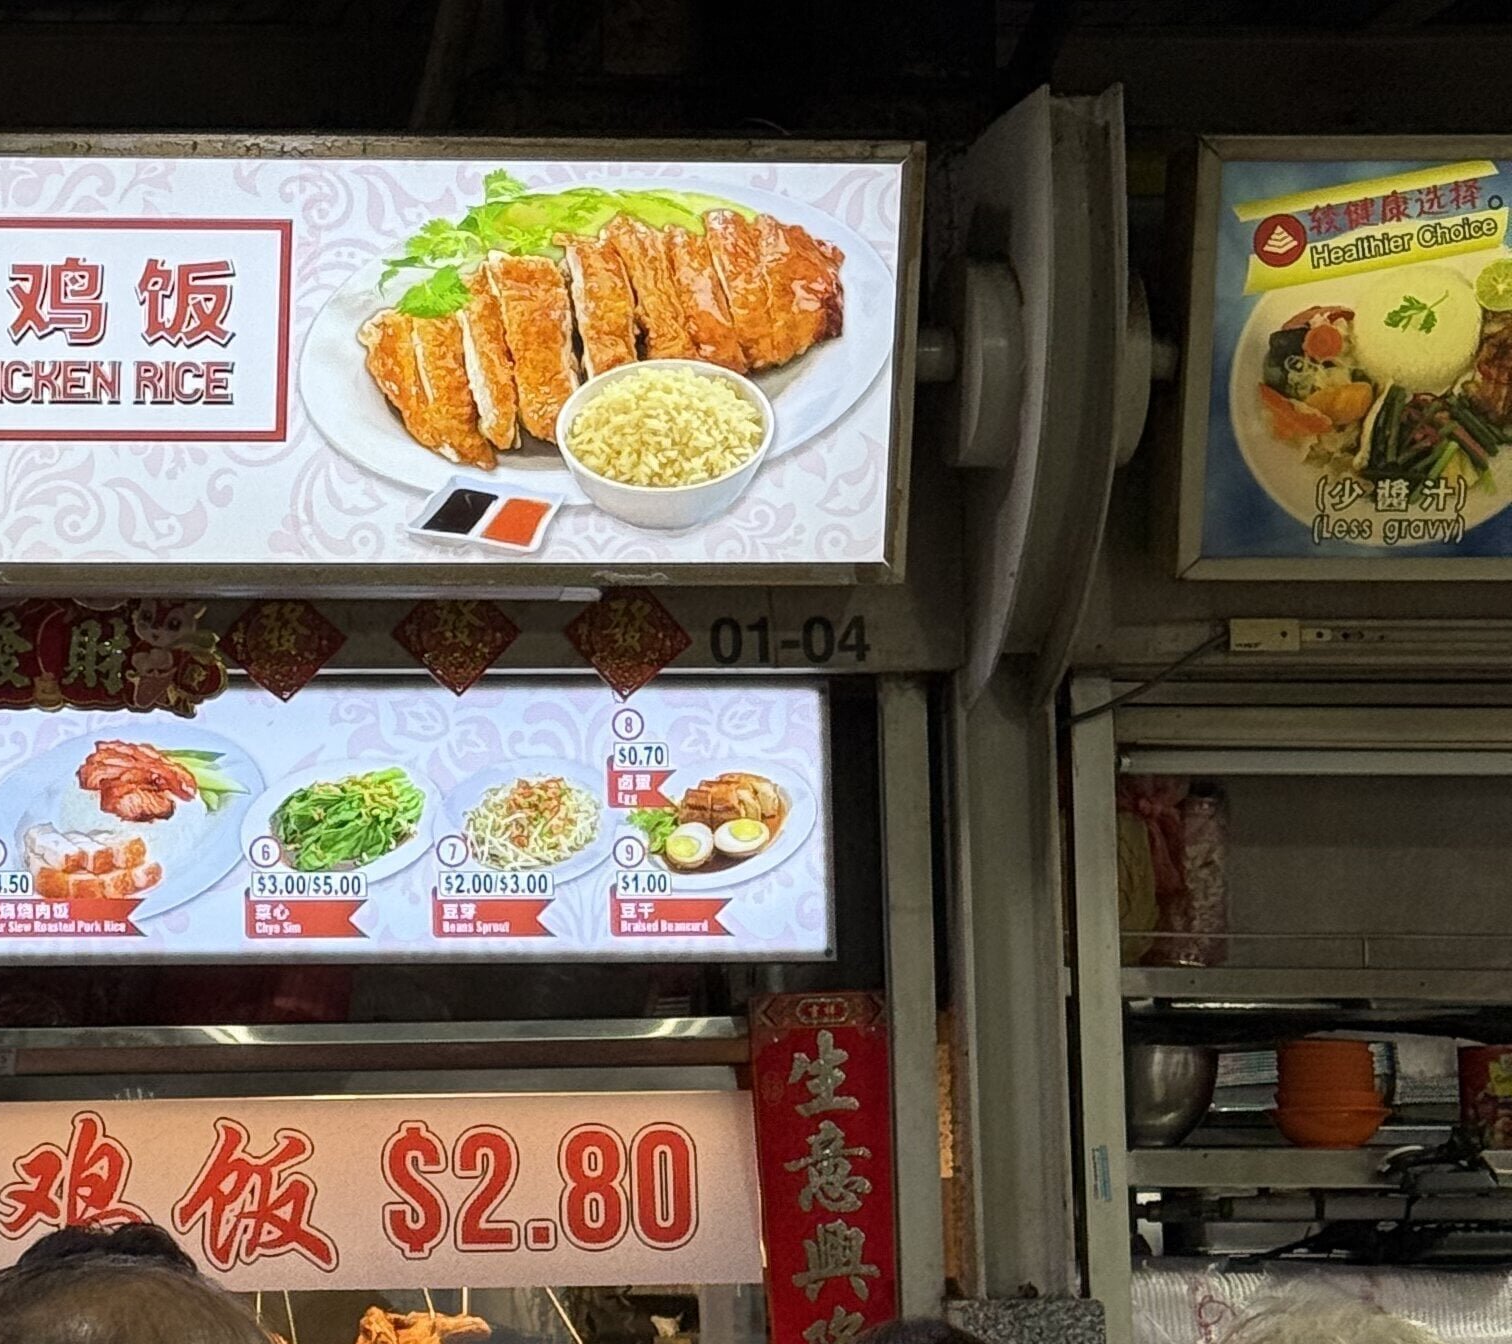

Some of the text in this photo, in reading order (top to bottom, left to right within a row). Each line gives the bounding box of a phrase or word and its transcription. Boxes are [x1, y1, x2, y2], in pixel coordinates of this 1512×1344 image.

[1311, 216, 1498, 269] Healthier Choice
[133, 361, 235, 406] RICE
[1312, 514, 1466, 546] (Less gravy)
[710, 615, 872, 665] 01-04
[619, 746, 664, 766] $0.70
[258, 874, 361, 895] $3.00/$5.00
[445, 873, 548, 894] $2.00/$3.00
[622, 873, 667, 893] $1.00
[33, 921, 76, 933] Roasted
[77, 921, 102, 933] Pork
[104, 921, 126, 933] Rice
[620, 920, 709, 933] Braised Beancurd
[382, 1119, 697, 1260] $2.80
